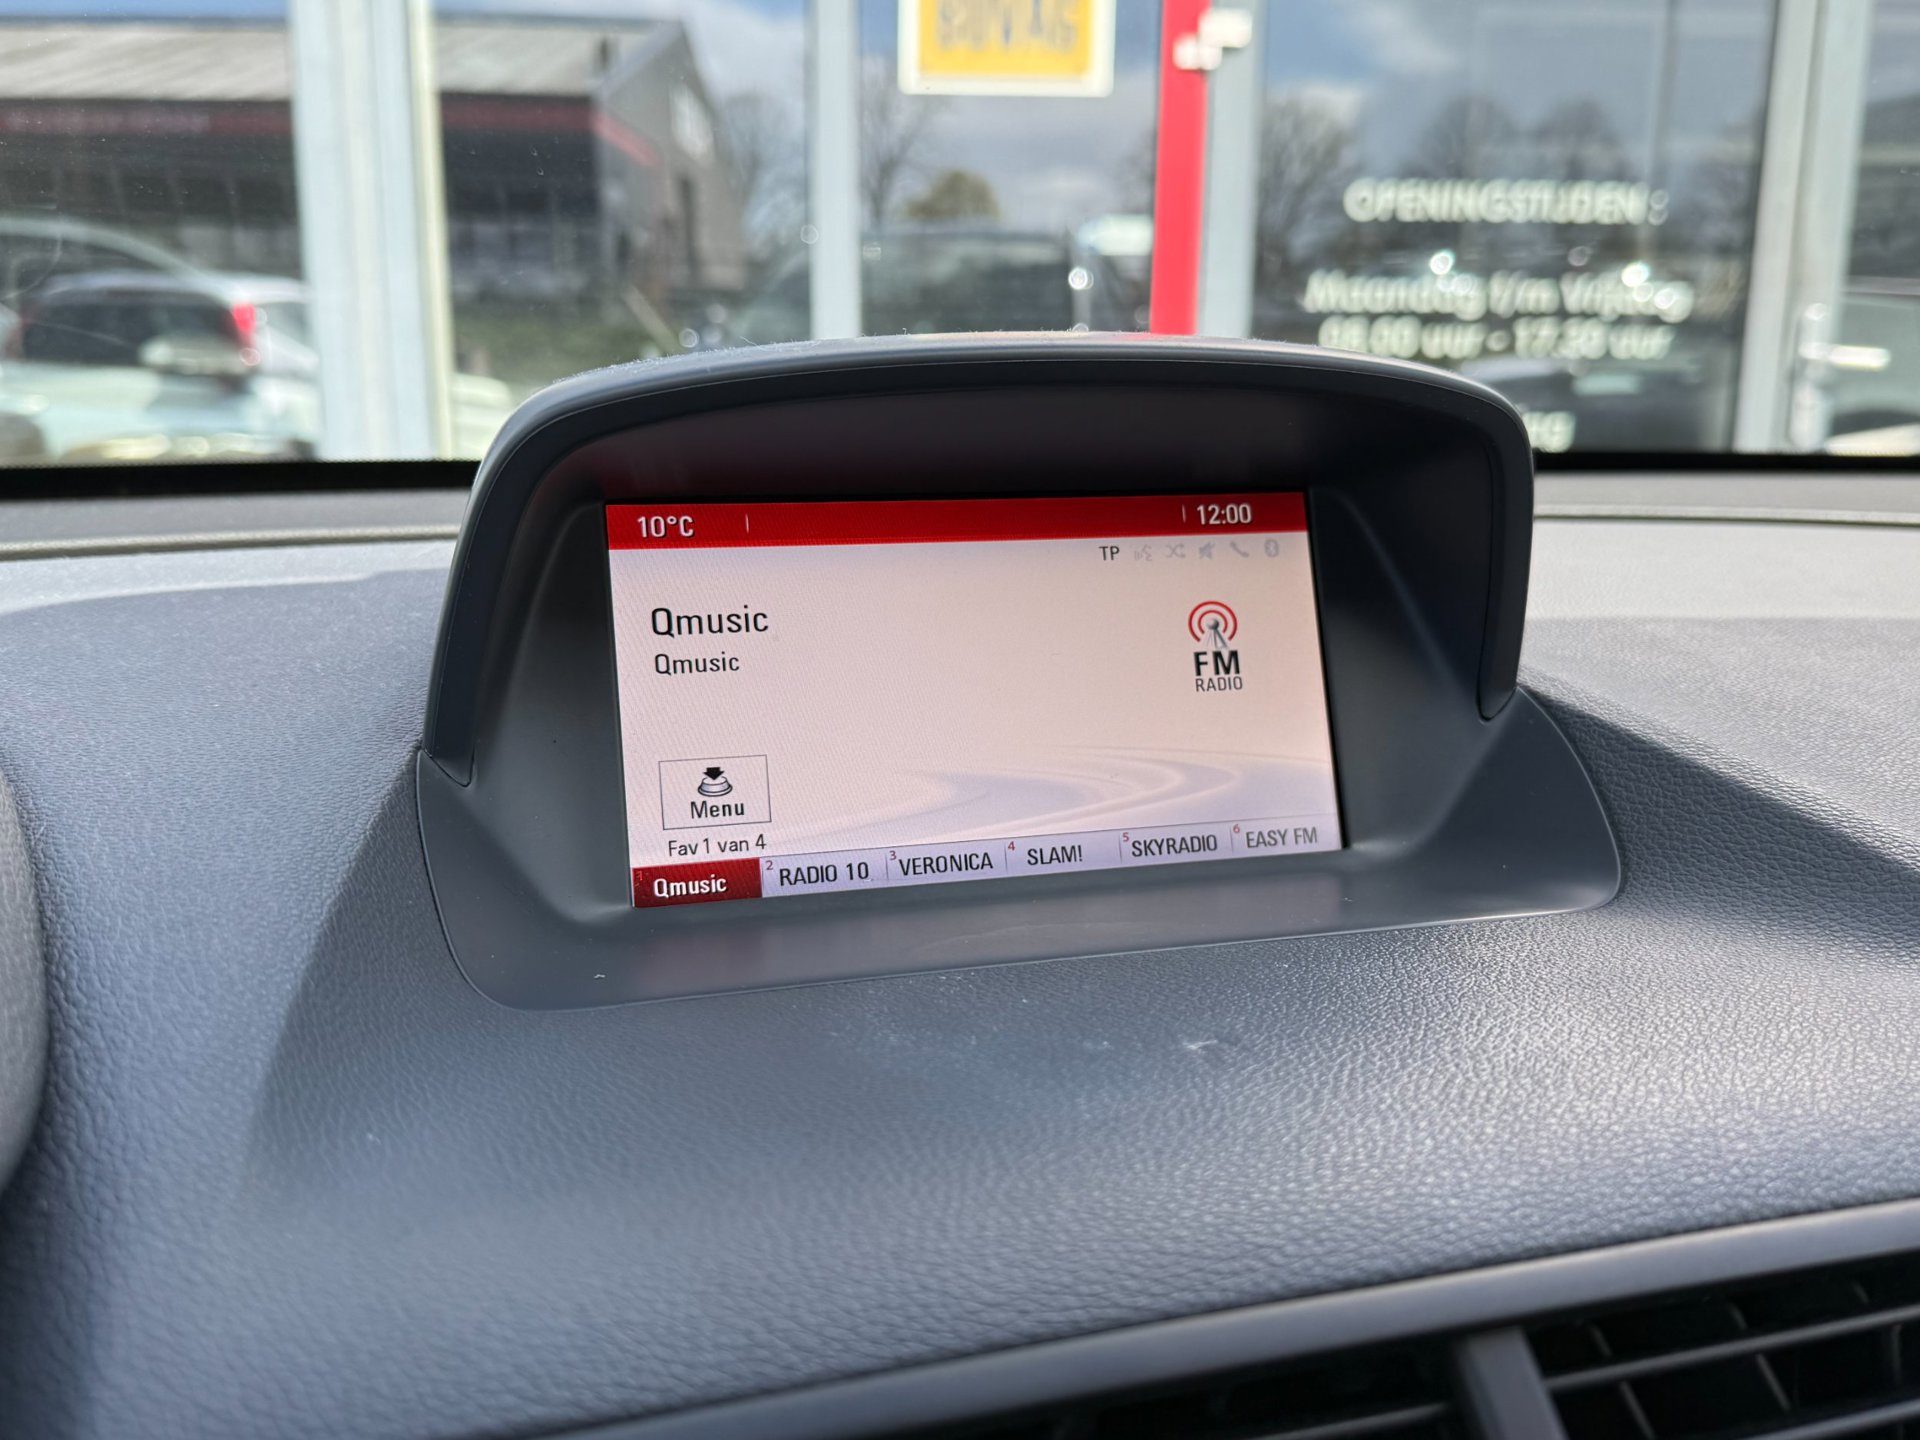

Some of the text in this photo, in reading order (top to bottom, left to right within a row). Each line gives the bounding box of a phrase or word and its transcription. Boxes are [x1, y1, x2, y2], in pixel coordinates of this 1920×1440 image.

[637, 515, 695, 538] 10°C
[1196, 503, 1252, 525] 12:00
[1099, 546, 1120, 561] TP
[651, 605, 769, 638] Qmusic
[654, 651, 740, 676] Qmusic
[1193, 650, 1241, 677] FM
[1195, 676, 1243, 692] RADIO
[690, 800, 746, 819] Menu
[668, 834, 767, 857] Fav 1 van 4
[1122, 832, 1218, 857] 5 SKYRADIO
[1232, 824, 1318, 849] 6 EASY FM
[889, 850, 994, 877] 3 VERONICA
[1007, 841, 1083, 866] 4 SLAM!
[653, 873, 728, 898] Qmusic
[766, 860, 869, 887] 2 RADIO 10
